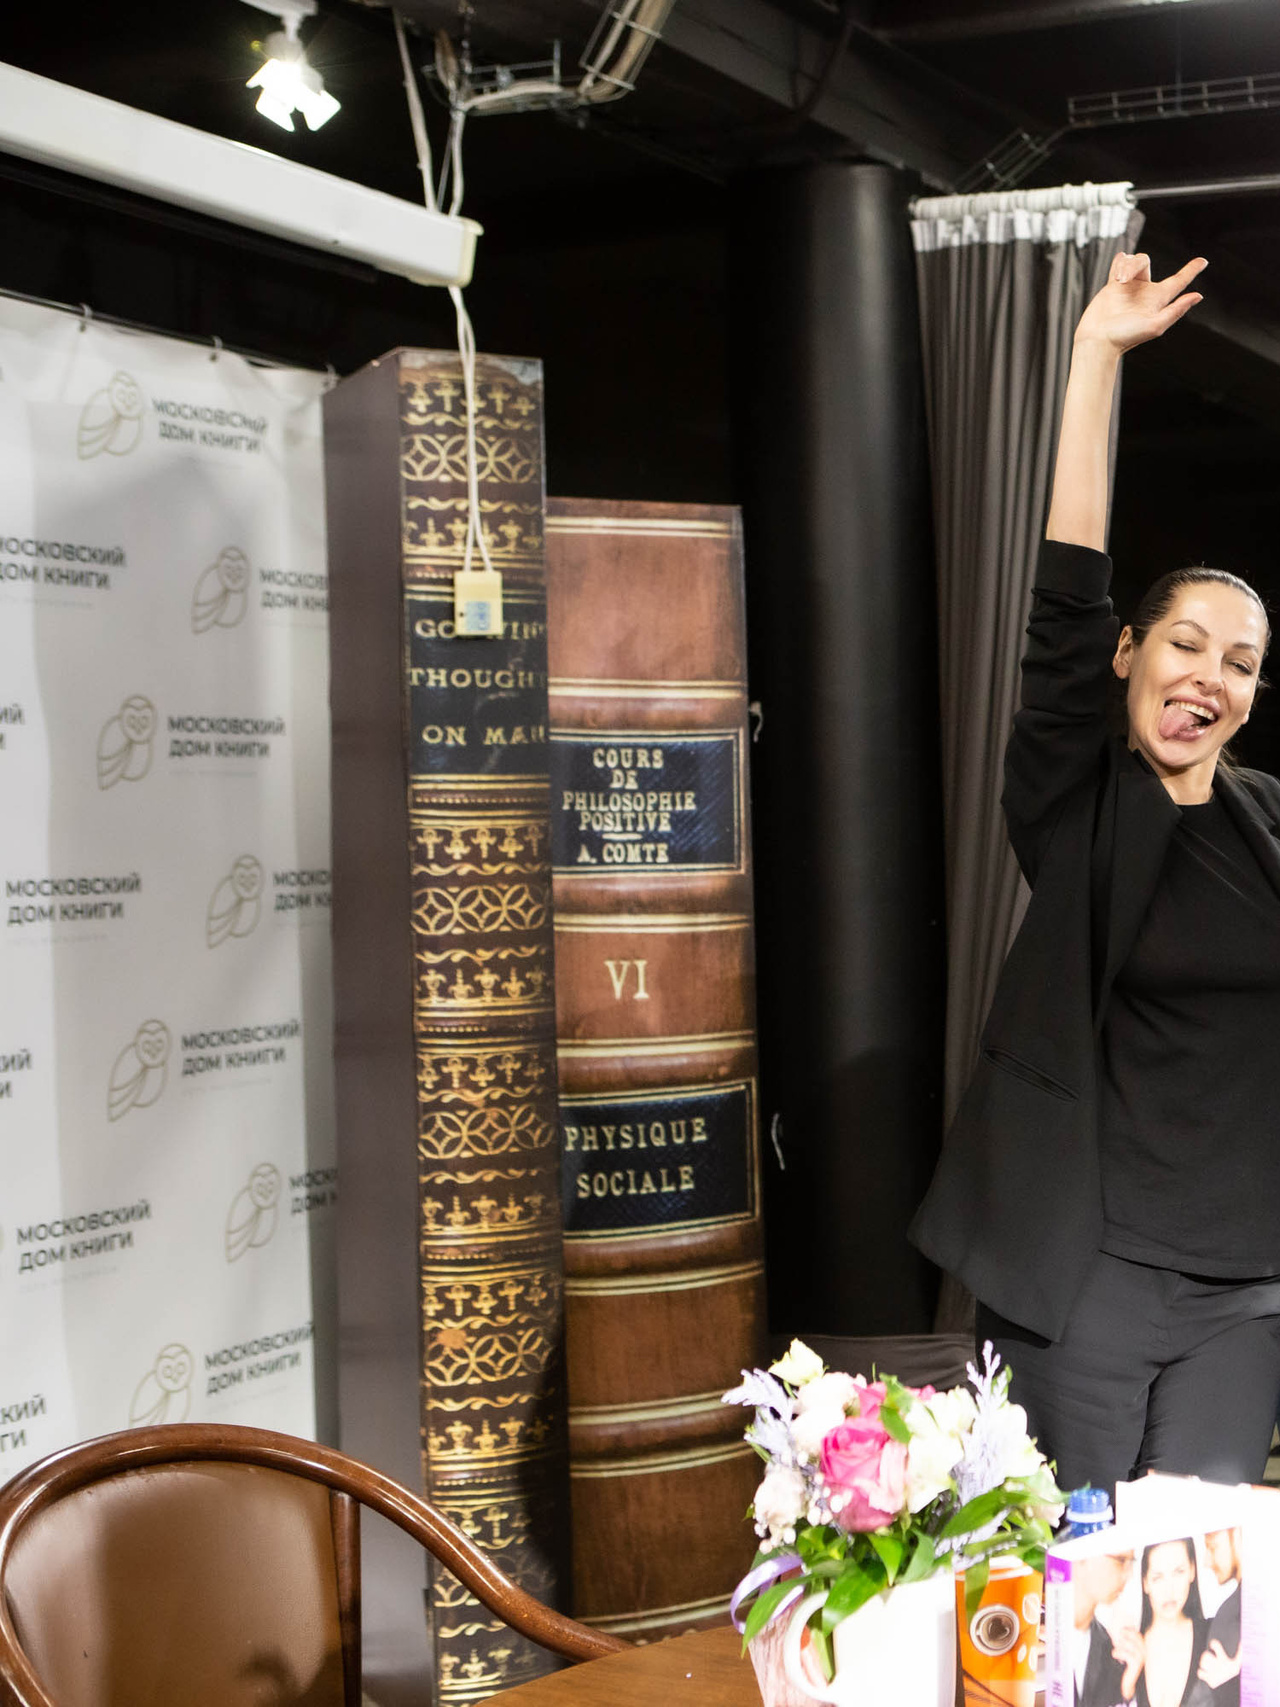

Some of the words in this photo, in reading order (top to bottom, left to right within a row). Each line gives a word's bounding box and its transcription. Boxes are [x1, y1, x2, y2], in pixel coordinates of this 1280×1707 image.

[152, 398, 268, 437] МОСКОВСКИЙ
[159, 421, 194, 442] ДОМ
[199, 430, 261, 453] КНИГИ
[0, 536, 127, 568] ОСКОВСКИЙ
[43, 566, 111, 591] КНИГИ
[261, 591, 298, 609] ДОМ
[168, 715, 286, 736] МОСКОВСКИЙ
[422, 724, 467, 746] ON
[169, 739, 211, 759] ДОМ
[214, 741, 270, 758] КНИГИ
[593, 748, 664, 769] COURS
[609, 769, 639, 790] DE
[562, 791, 697, 812] PHILOSOPHIE
[579, 811, 672, 833] POSITIVE
[577, 844, 598, 864] A.
[602, 842, 669, 863] COMTE
[6, 872, 142, 898] МОСКОВСКИЙ
[7, 905, 54, 927] ДОМ
[60, 902, 124, 920] КНИГИ
[274, 894, 312, 912] ДОМ
[604, 960, 649, 1000] VI
[181, 1019, 301, 1051] МОСКОВСКИЙ
[182, 1055, 222, 1077] ДОМ
[225, 1047, 286, 1068] КНИГИ
[564, 1117, 707, 1151] PHYSIQUE
[576, 1164, 695, 1198] SOCIALE
[17, 1199, 152, 1245] МОСКОВСКИЙ
[18, 1246, 66, 1275] ДОМ
[69, 1231, 134, 1260] КНИГИ
[205, 1321, 315, 1371] МОСКОВСКИЙ
[206, 1368, 244, 1397] ДОМ
[246, 1351, 302, 1380] КНИГИ
